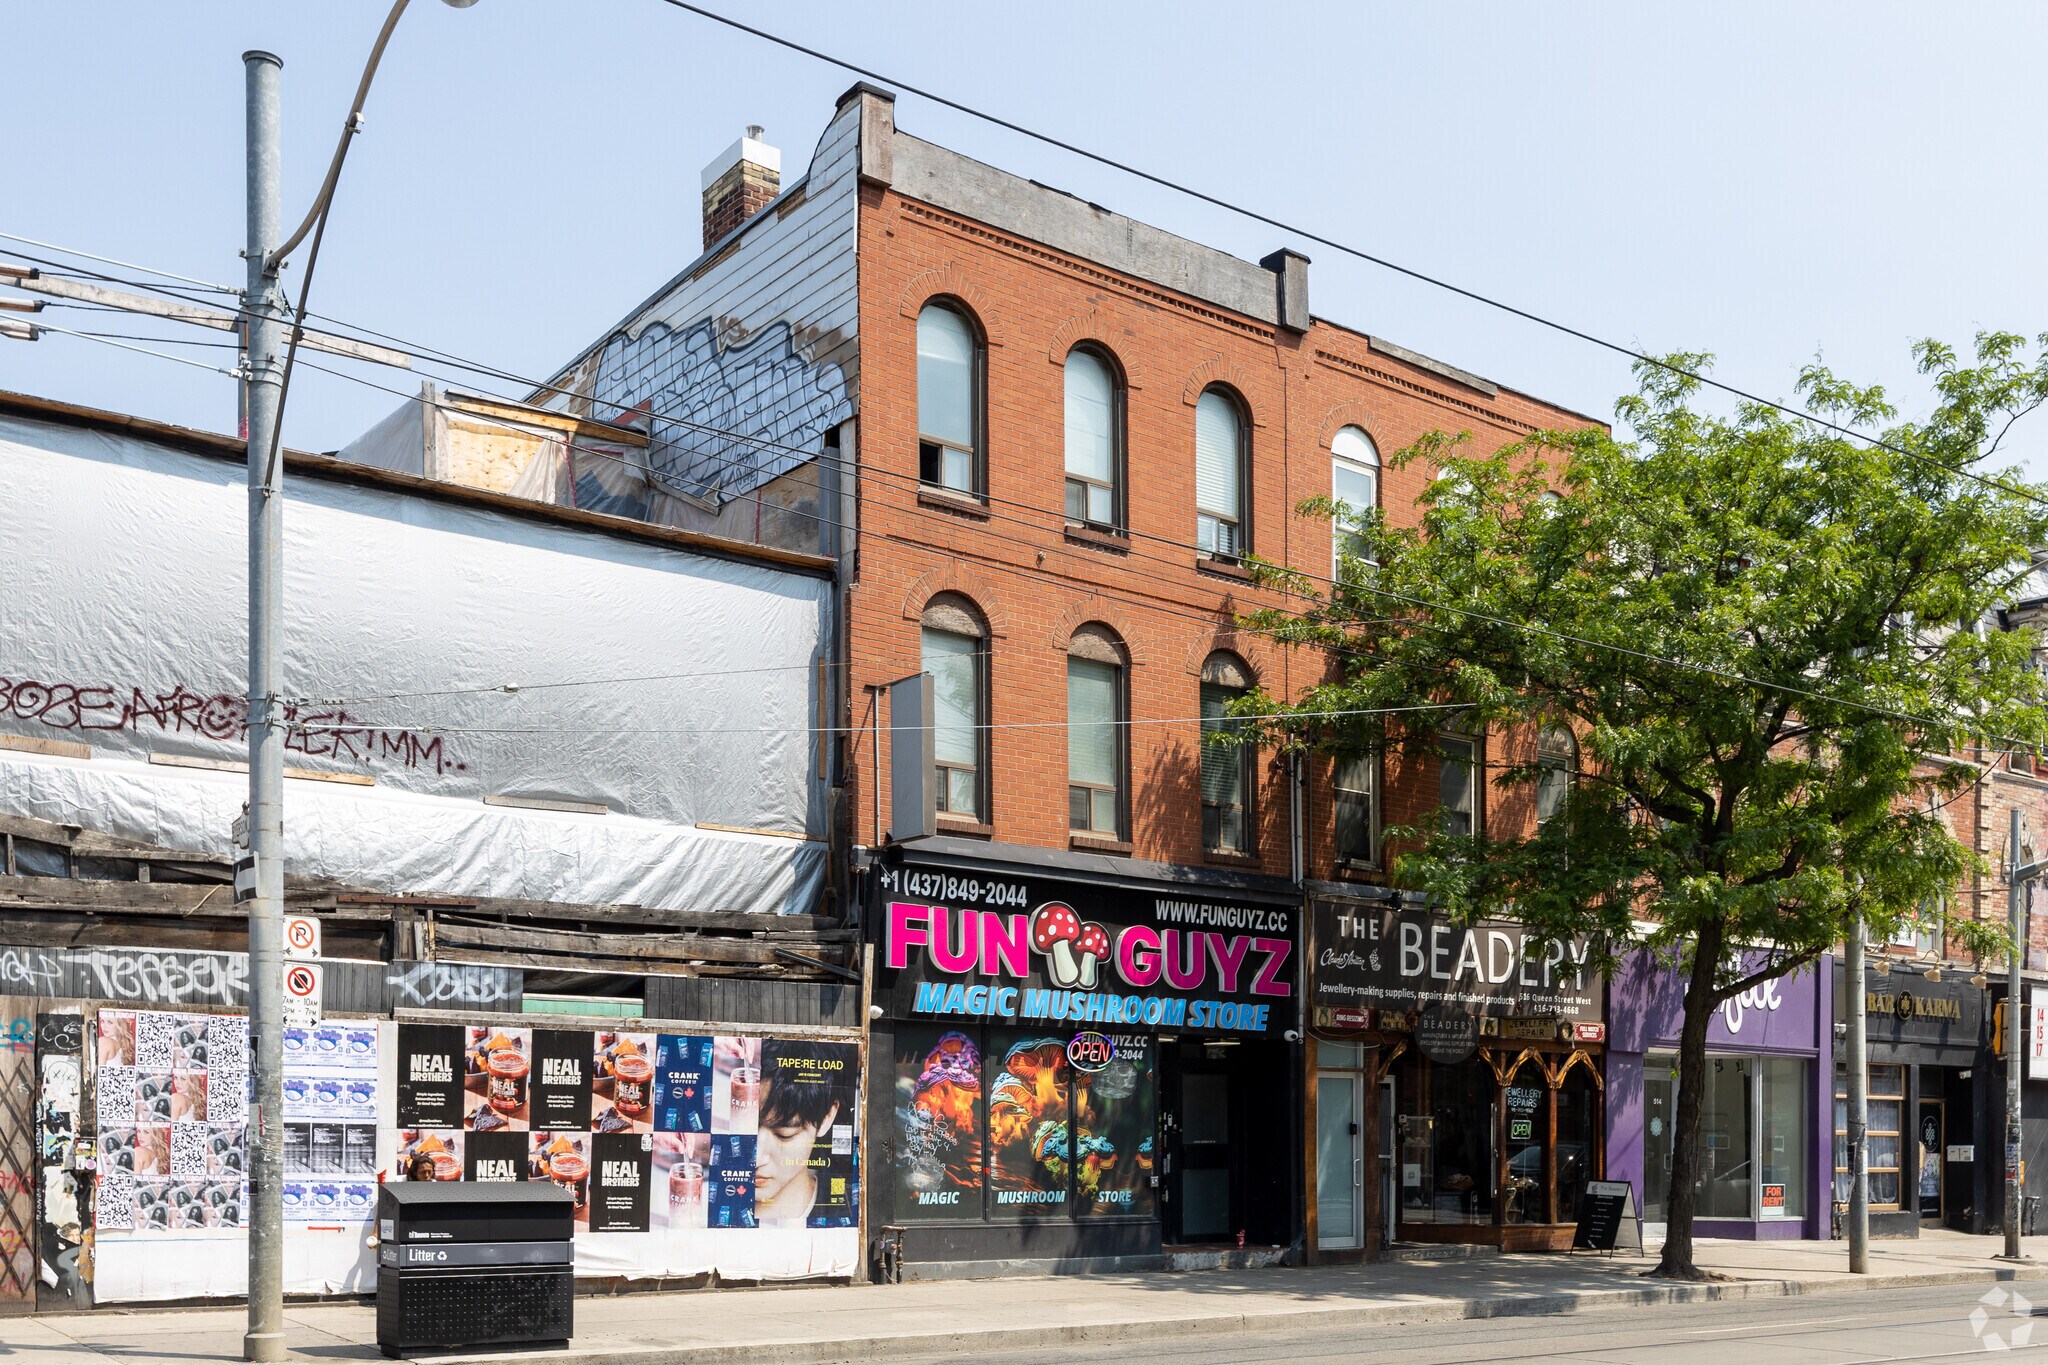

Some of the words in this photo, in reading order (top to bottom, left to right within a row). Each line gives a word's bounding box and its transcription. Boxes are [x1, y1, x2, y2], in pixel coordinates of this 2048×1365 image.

[880, 870, 899, 892] +1
[904, 872, 1028, 908] (437)849-2044
[1156, 900, 1288, 932] WWW.FUNGUYZ.CC
[886, 901, 1030, 978] FUN
[1114, 924, 1291, 996] GUYZ
[1338, 916, 1378, 940] THE
[1400, 922, 1590, 990] BEADERY
[1319, 983, 1384, 998] Jewellery-making
[1385, 988, 1416, 1000] supplies,
[1418, 990, 1442, 1002] repairs
[1444, 992, 1456, 1000] and
[1458, 992, 1485, 1002] finished
[1486, 994, 1514, 1006] products
[1532, 994, 1552, 1002] Queen
[1554, 996, 1574, 1004] Street
[1576, 997, 1592, 1005] West
[304, 997, 318, 1006] 10AM
[913, 982, 1018, 1018] MAGIC
[1021, 988, 1188, 1026] MUSHROOM
[1188, 1000, 1270, 1032] STORE
[1866, 992, 1895, 1014] BAR
[1916, 996, 1962, 1018] KARMA
[306, 1008, 316, 1016] 7PM
[2038, 1008, 2044, 1022] 14
[1424, 1020, 1472, 1030] BEADERY
[2037, 1026, 2043, 1039] 15
[1070, 1042, 1110, 1062] OPEN
[2036, 1044, 2043, 1056] 17
[410, 1054, 452, 1072] NEAL
[543, 1058, 581, 1076] NEAL
[776, 1058, 816, 1069] TAPE:RE
[818, 1060, 844, 1070] LOAD
[410, 1072, 452, 1082] BROTHERS
[542, 1076, 581, 1085] BROTHERS
[1508, 1097, 1537, 1108] REPAIRS
[1514, 1124, 1529, 1135] OPEN
[477, 1160, 516, 1177] NEAL
[602, 1161, 640, 1177] NEAL
[602, 1177, 640, 1186] BROTHERS
[918, 1191, 959, 1205] MAGIC
[997, 1190, 1065, 1204] MUSHROOM
[1098, 1190, 1132, 1202] STORE
[1766, 1186, 1782, 1196] FOR
[1763, 1197, 1784, 1207] RENT
[409, 1249, 436, 1261] Litter
